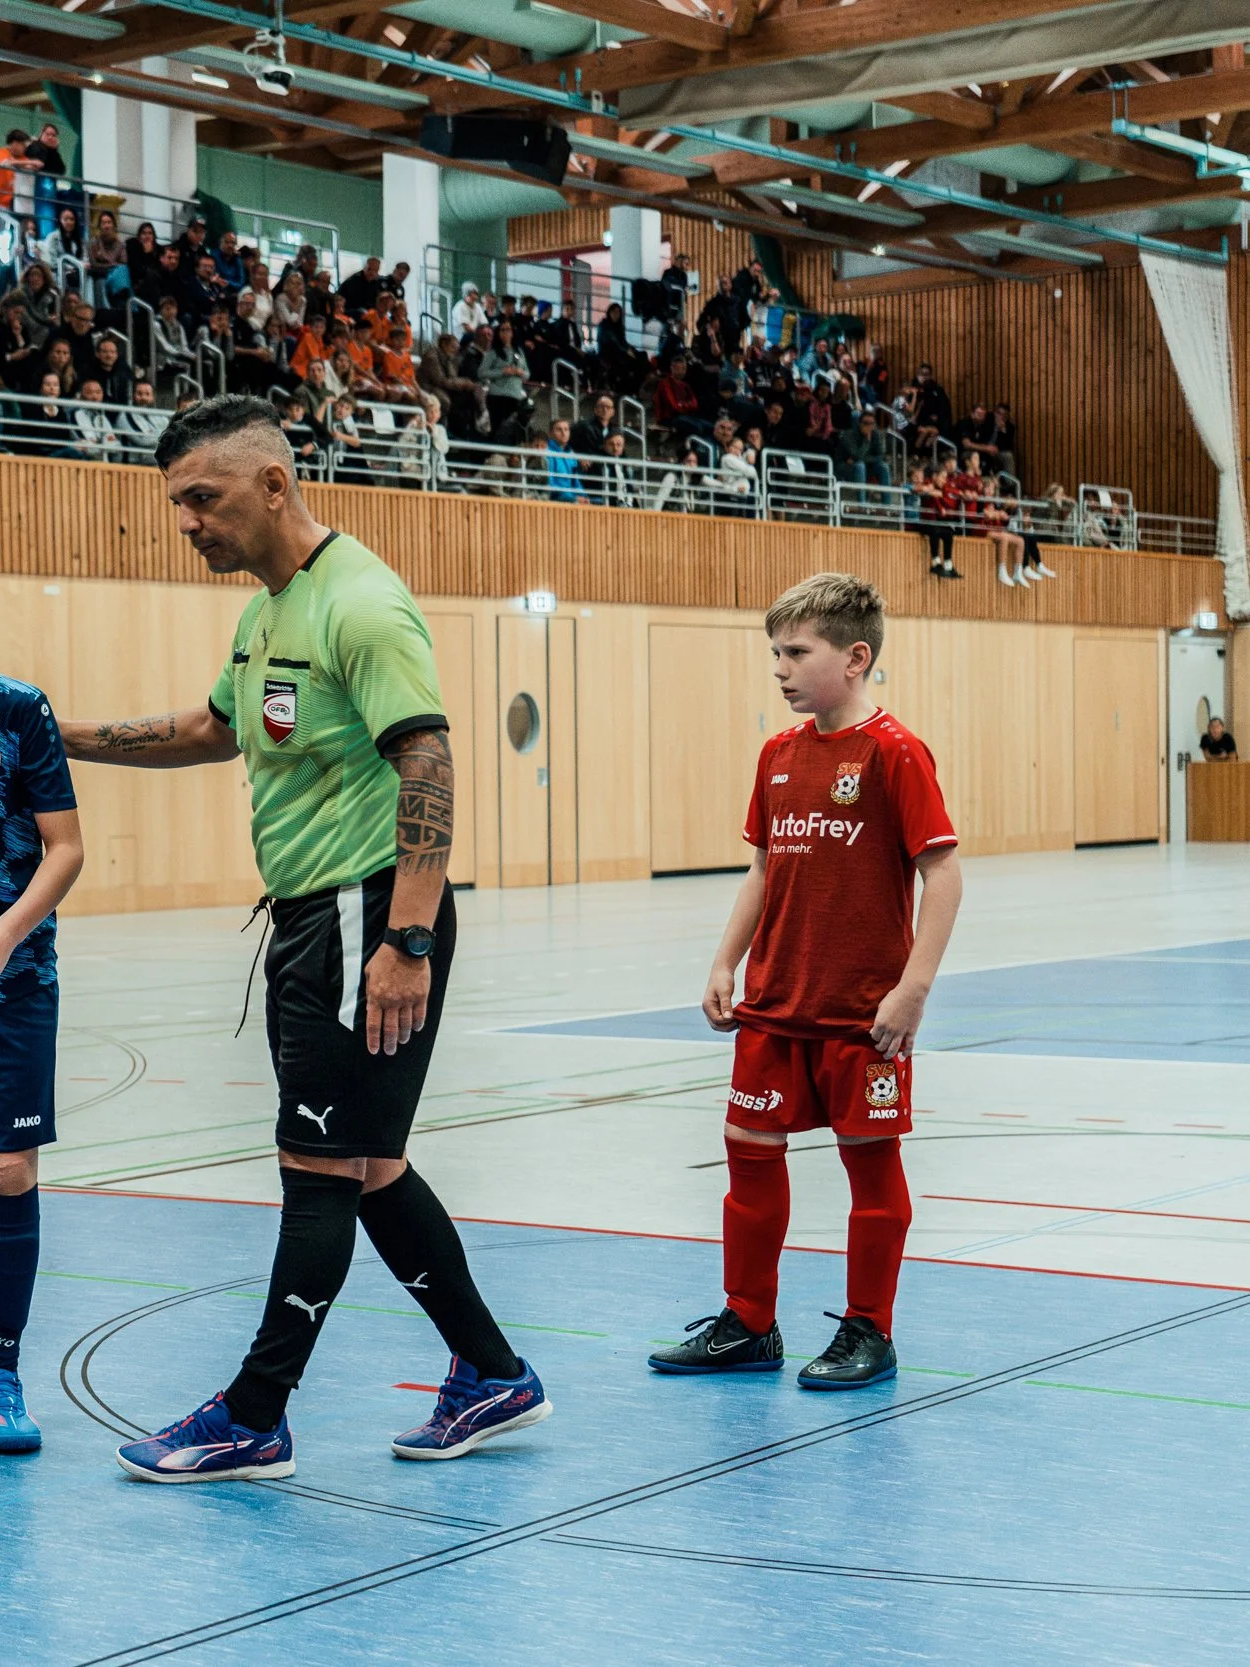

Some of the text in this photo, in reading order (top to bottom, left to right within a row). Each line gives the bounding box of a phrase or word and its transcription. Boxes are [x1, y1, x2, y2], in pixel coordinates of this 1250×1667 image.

[836, 762, 863, 775] SVS
[772, 843, 812, 854] tun mehr.
[866, 1063, 896, 1077] SVS
[868, 1108, 898, 1119] JAKO
[13, 1114, 41, 1128] JAKO
